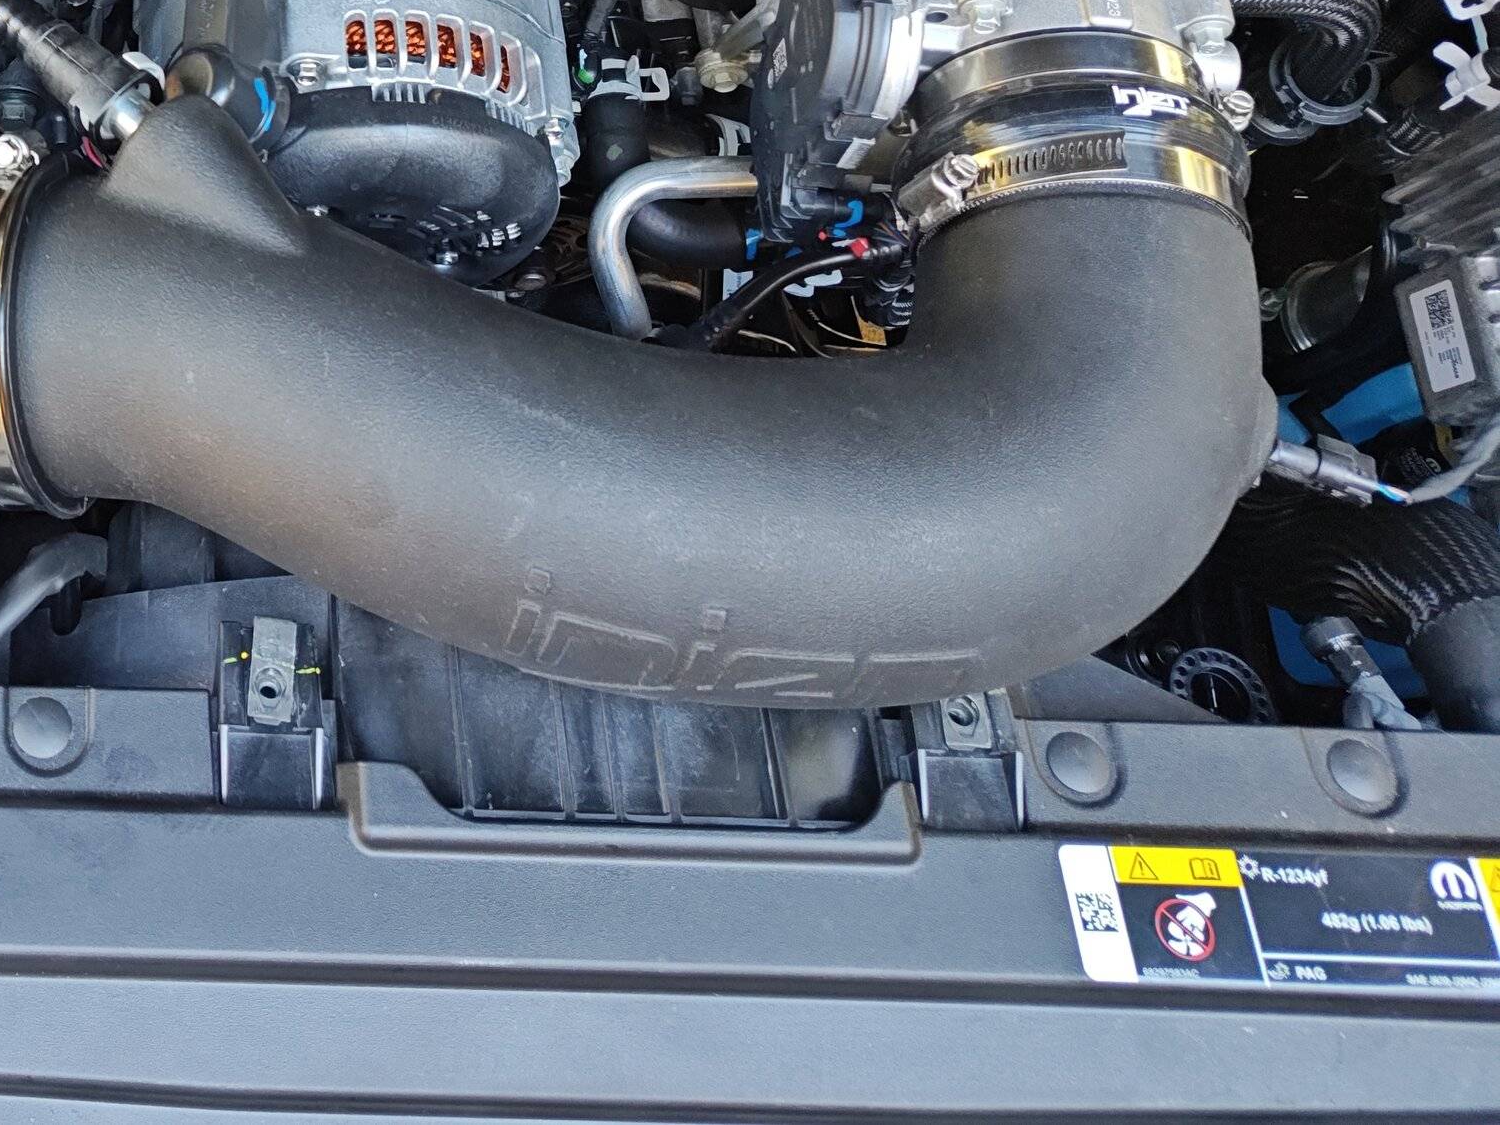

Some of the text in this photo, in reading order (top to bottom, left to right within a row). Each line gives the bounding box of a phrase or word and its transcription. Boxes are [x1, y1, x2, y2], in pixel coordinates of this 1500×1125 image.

[1260, 866, 1329, 888] R-1234yf
[1360, 912, 1401, 933] (1.06
[1294, 965, 1328, 981] PAG
